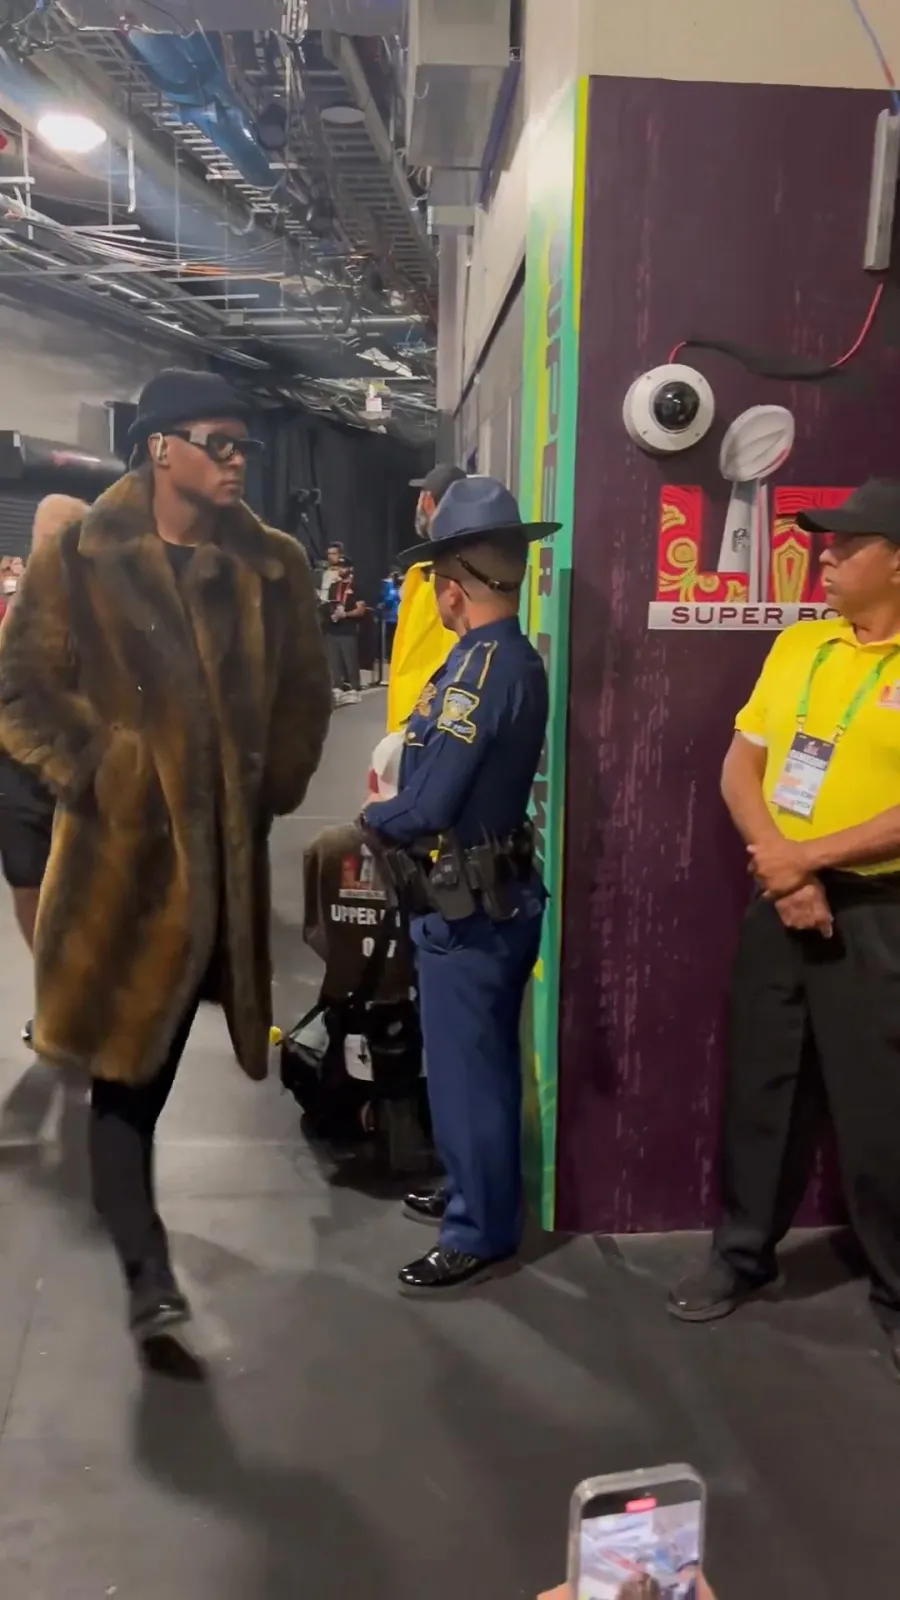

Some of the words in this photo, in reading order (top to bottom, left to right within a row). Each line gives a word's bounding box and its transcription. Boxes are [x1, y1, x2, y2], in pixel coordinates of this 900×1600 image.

[670, 606, 784, 625] SUPER
[798, 607, 841, 621] BO
[331, 904, 378, 925] UPPER
